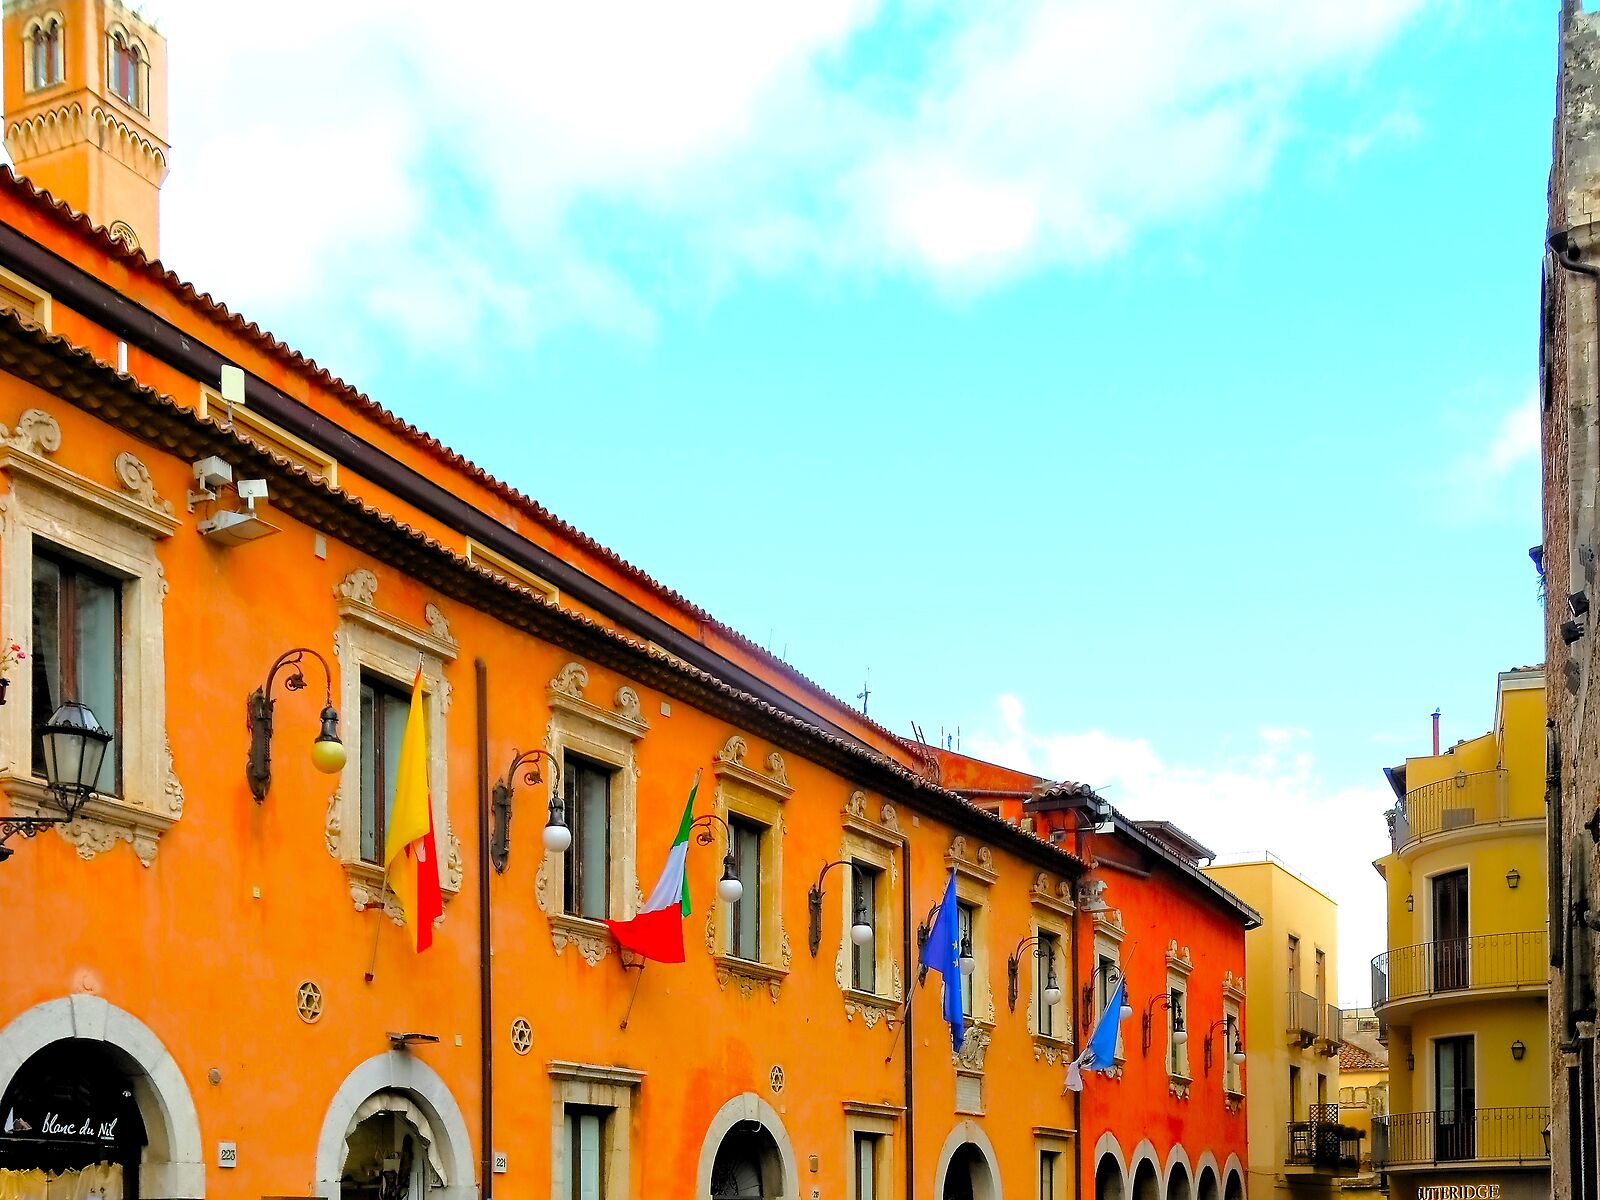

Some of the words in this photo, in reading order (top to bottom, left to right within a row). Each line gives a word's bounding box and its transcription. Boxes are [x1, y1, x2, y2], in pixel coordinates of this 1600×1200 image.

[79, 1117, 94, 1136] du
[98, 1117, 118, 1138] Nil
[496, 1158, 505, 1167] 221
